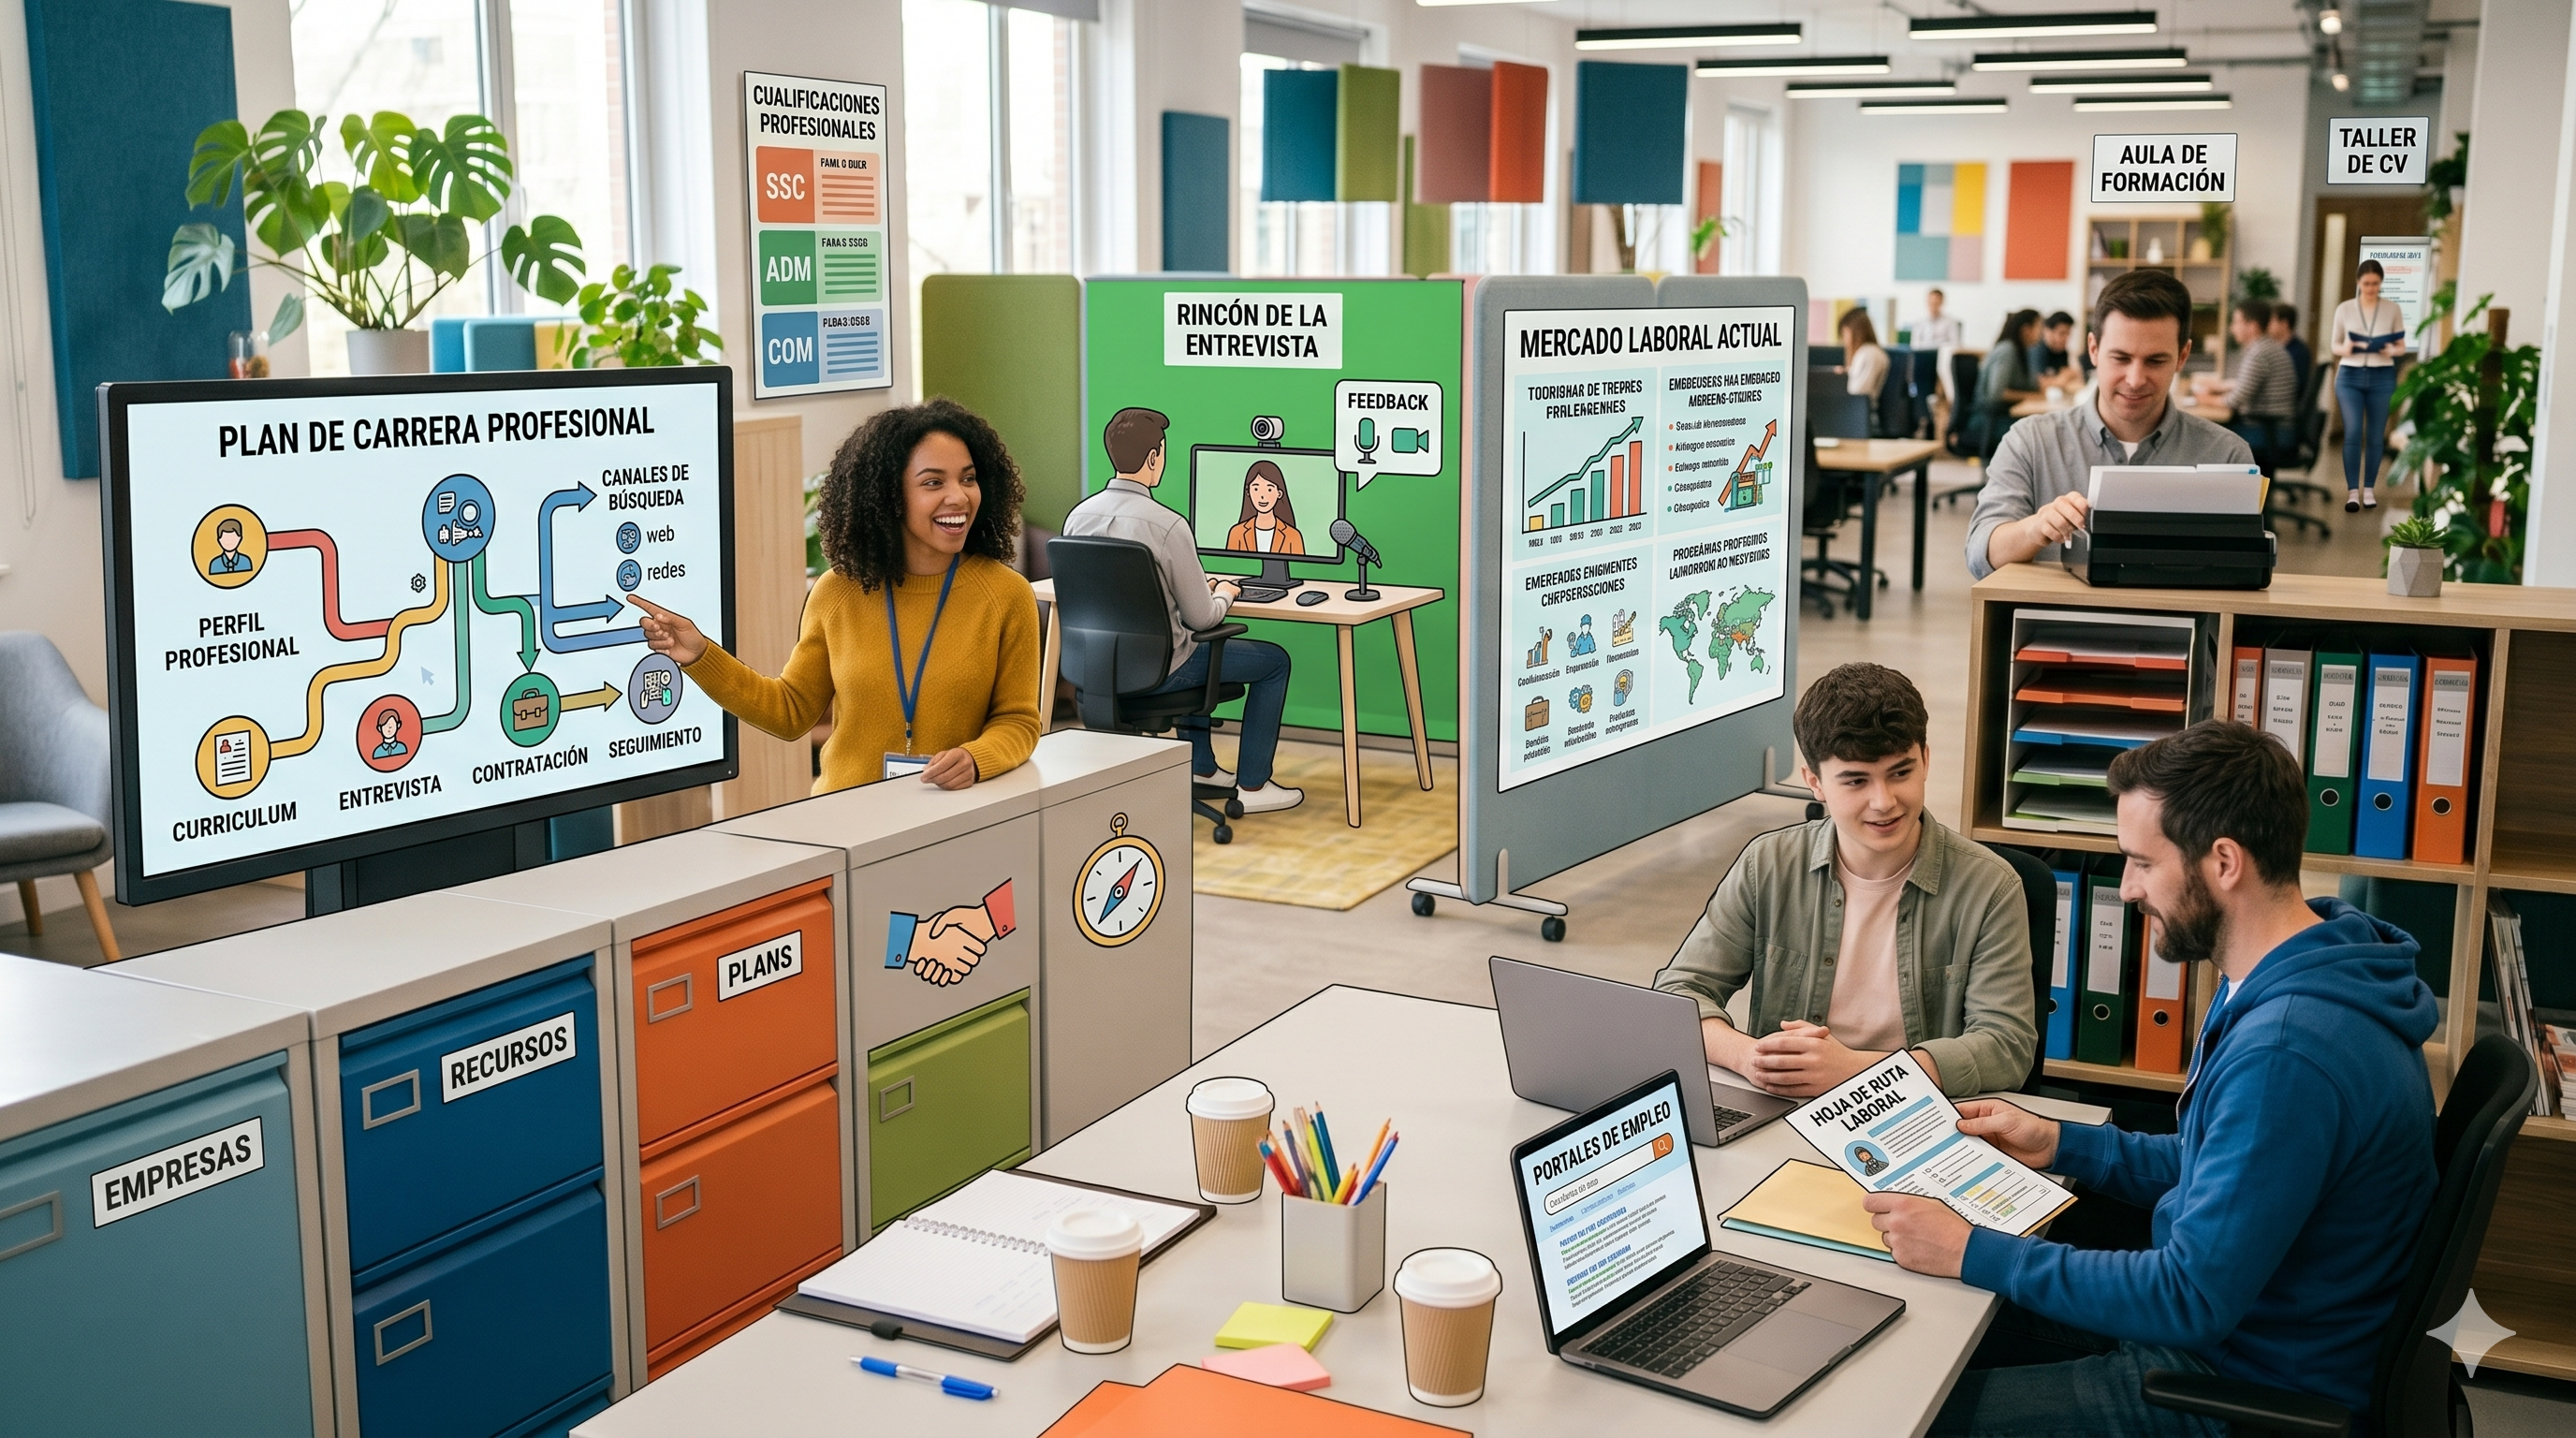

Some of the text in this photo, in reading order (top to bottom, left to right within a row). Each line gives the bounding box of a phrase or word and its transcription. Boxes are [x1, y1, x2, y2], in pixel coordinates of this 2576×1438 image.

[753, 84, 880, 115] CUALIFICACIONES
[760, 112, 876, 140] PROFESIONALES
[2339, 127, 2417, 148] TALLER
[2119, 144, 2208, 165] AULA DE
[2348, 154, 2408, 174] DE CV
[765, 172, 806, 201] SSC
[2101, 167, 2225, 192] FORMACIÓN
[766, 256, 812, 283] ADM
[1178, 298, 1328, 328] RINCÓN DE LA
[768, 336, 813, 366] COM
[1186, 333, 1319, 358] ENTREVISTA
[1520, 322, 1782, 359] MERCADO LABORAL ACTUAL
[1348, 392, 1428, 411] FEEDBACK
[1588, 382, 1601, 397] DE
[219, 406, 655, 458] PLAN DE CARRERA PROFESIONAL
[602, 463, 690, 487] CANALES DE
[608, 488, 684, 511] BÚSQUEDA
[646, 526, 675, 544] web
[647, 561, 686, 581] redes
[199, 611, 265, 638] PERFIL
[165, 636, 300, 671] PROFESIONAL
[608, 726, 702, 758] SEGUIMIENTO
[472, 744, 588, 785] CONTRATACIÓN
[339, 774, 443, 811] ENTREVISTA
[172, 800, 297, 843] CURRICULUM
[728, 945, 793, 988] PLANS
[450, 1026, 567, 1090] RECURSOS
[1809, 1064, 1910, 1127] HOJA DE RUTA
[1839, 1089, 1908, 1133] LABORAL
[1532, 1100, 1671, 1186] PORTALES DE EMPLEO
[105, 1134, 252, 1211] EMPRESAS
